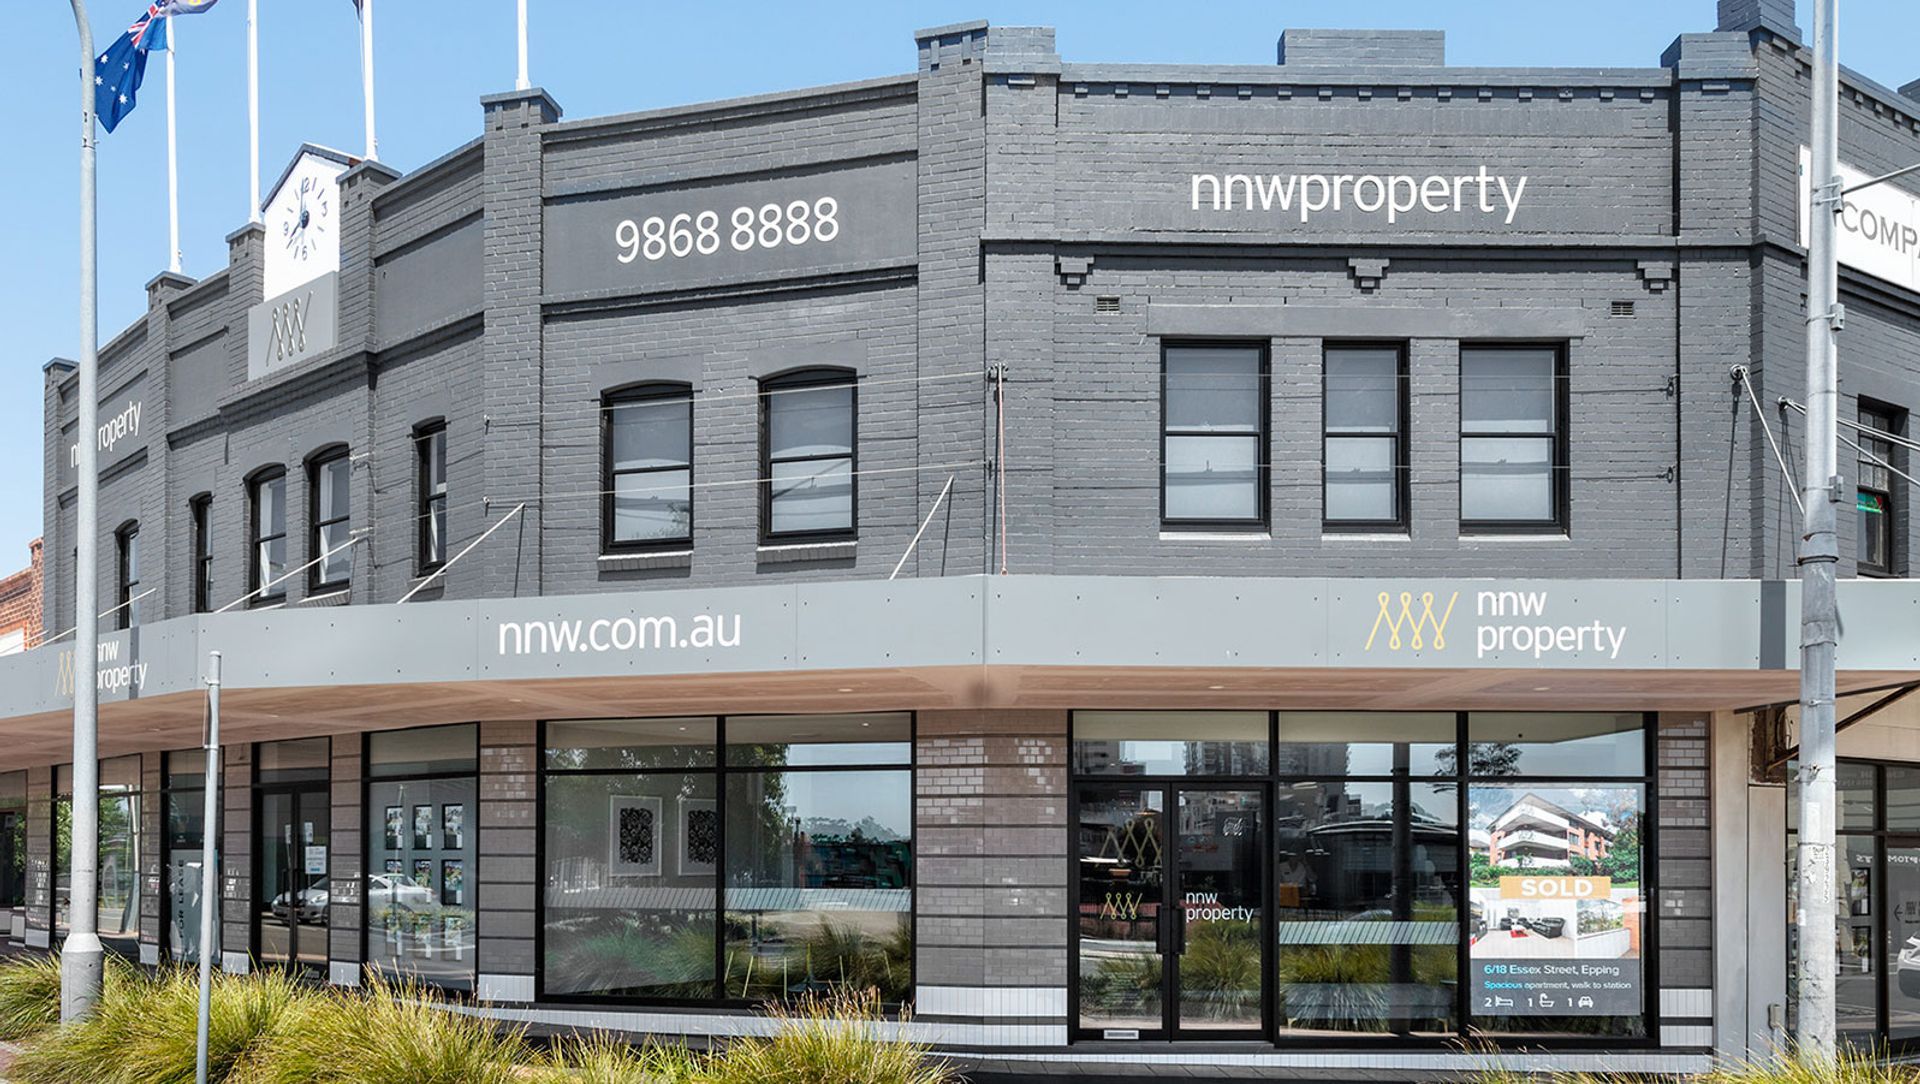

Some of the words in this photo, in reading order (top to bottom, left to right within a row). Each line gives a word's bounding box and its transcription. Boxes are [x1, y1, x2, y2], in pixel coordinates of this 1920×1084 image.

[1191, 165, 1528, 224] nnwproperty
[321, 201, 328, 217] 3
[283, 221, 289, 236] 9
[615, 210, 720, 263] 9868
[730, 196, 839, 251] 8888
[1841, 201, 1920, 259] COMP
[301, 245, 308, 261] 6
[70, 401, 142, 468] nroperty
[1477, 591, 1547, 616] nnw
[499, 614, 741, 655] nnw.com.au
[1477, 620, 1627, 659] property
[1521, 879, 1593, 897] SOLD
[1185, 892, 1218, 904] nnw
[1185, 905, 1254, 923] property
[1484, 965, 1507, 975] 6/18
[1509, 965, 1541, 974] Essex
[1544, 965, 1579, 975] Street,
[1581, 965, 1620, 977] Epping
[1484, 981, 1522, 990] Spacious
[1524, 981, 1570, 990] apartment,
[1571, 981, 1591, 989] walk
[1593, 981, 1602, 989] to
[1603, 981, 1632, 989] station
[1484, 997, 1492, 1007] 2
[1527, 998, 1533, 1007] 1
[1567, 998, 1573, 1007] 1
